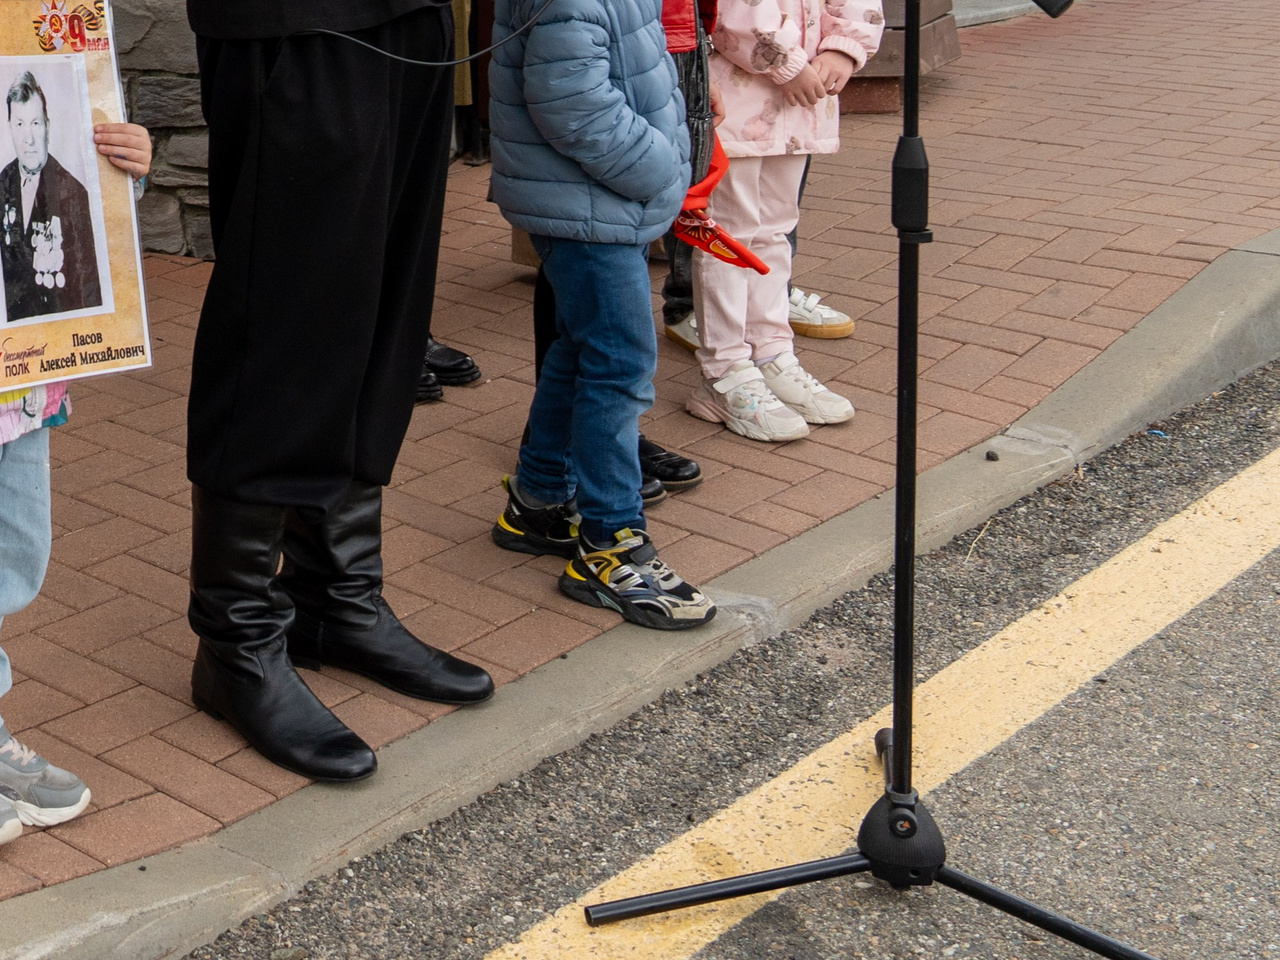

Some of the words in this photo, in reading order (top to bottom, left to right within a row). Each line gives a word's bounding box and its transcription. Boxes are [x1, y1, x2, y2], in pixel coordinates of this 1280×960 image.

[69, 13, 87, 53] 9
[72, 332, 103, 348] Пасов
[5, 361, 31, 378] ПОЛК
[40, 353, 78, 373] Алексей
[80, 345, 146, 366] Михайлович
